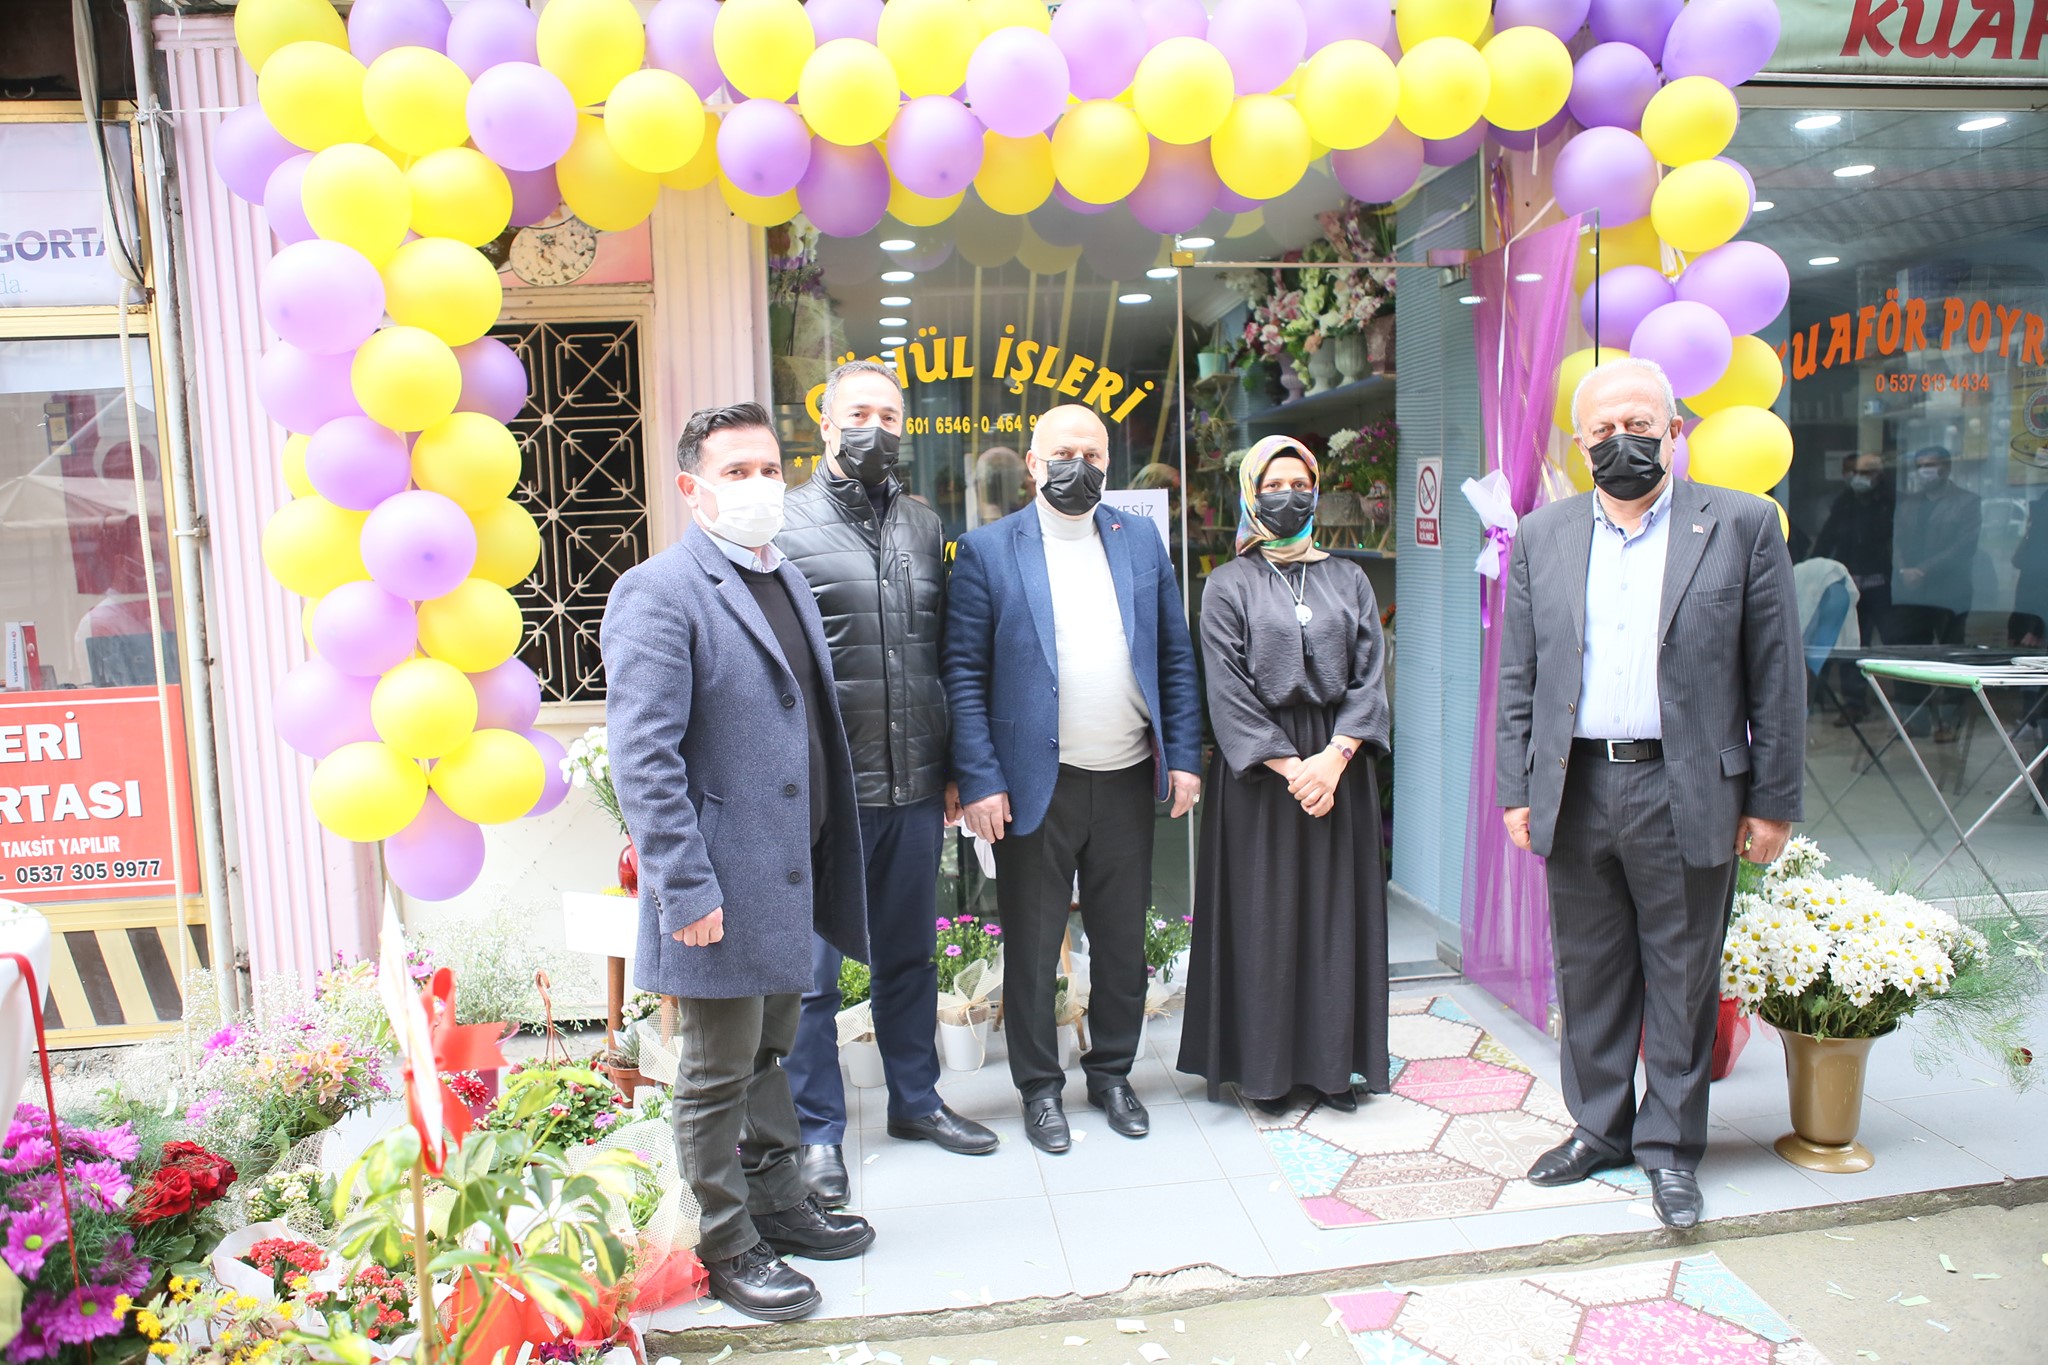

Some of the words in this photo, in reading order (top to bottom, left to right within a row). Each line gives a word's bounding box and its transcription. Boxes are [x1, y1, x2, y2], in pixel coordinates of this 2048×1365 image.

[1941, 297, 2046, 366] POYR
[992, 324, 1155, 424] İŞLERİ
[1889, 374, 1917, 392] 537
[1921, 373, 1946, 392] 913
[1950, 372, 1989, 392] 4434
[906, 416, 929, 434] 601
[996, 415, 1022, 432] 464
[2, 835, 54, 858] TAKSİT
[58, 836, 120, 855] YAPILIR
[16, 866, 63, 883] 0537
[71, 862, 107, 880] 305
[113, 860, 161, 878] 9977
